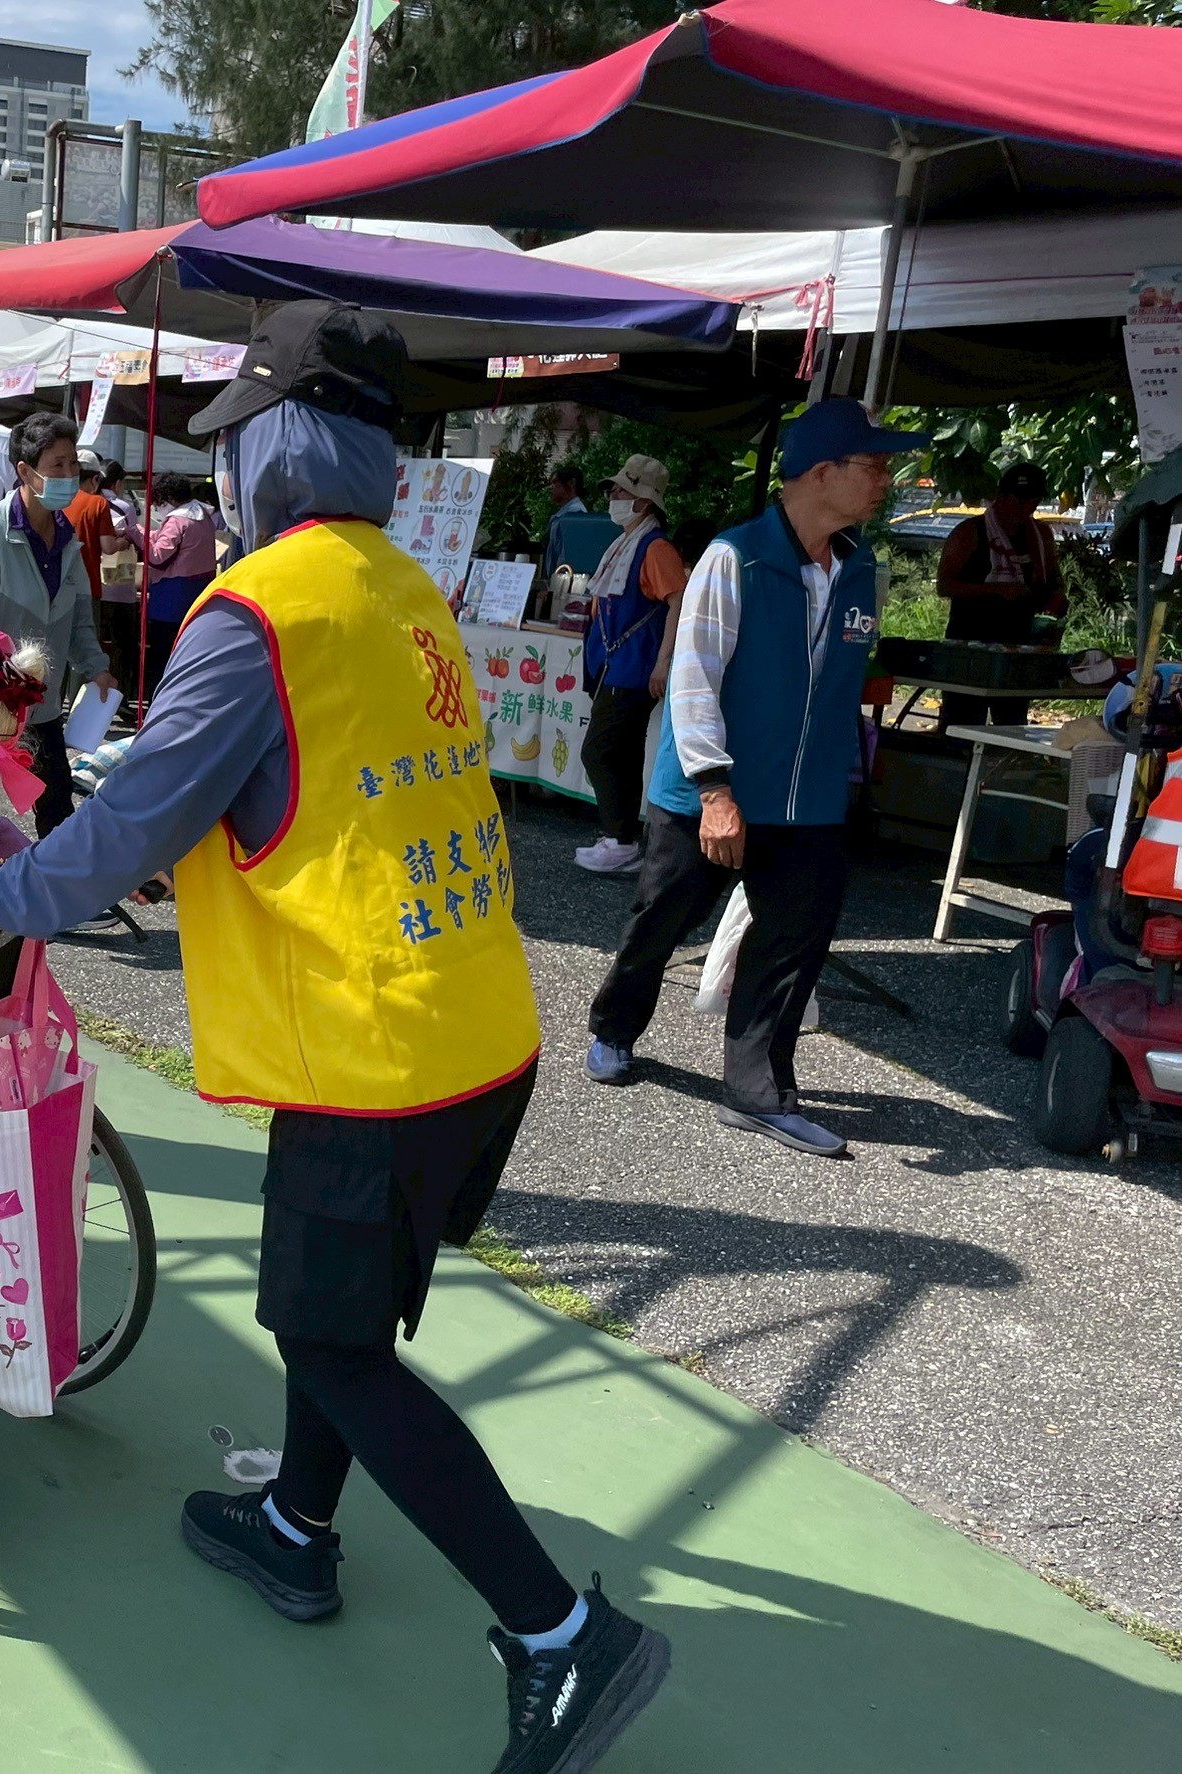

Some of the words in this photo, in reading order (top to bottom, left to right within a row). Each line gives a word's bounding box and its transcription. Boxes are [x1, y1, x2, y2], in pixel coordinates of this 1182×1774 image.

[498, 689, 573, 726] 新鮮水果
[357, 741, 484, 799] 臺灣花蓮地
